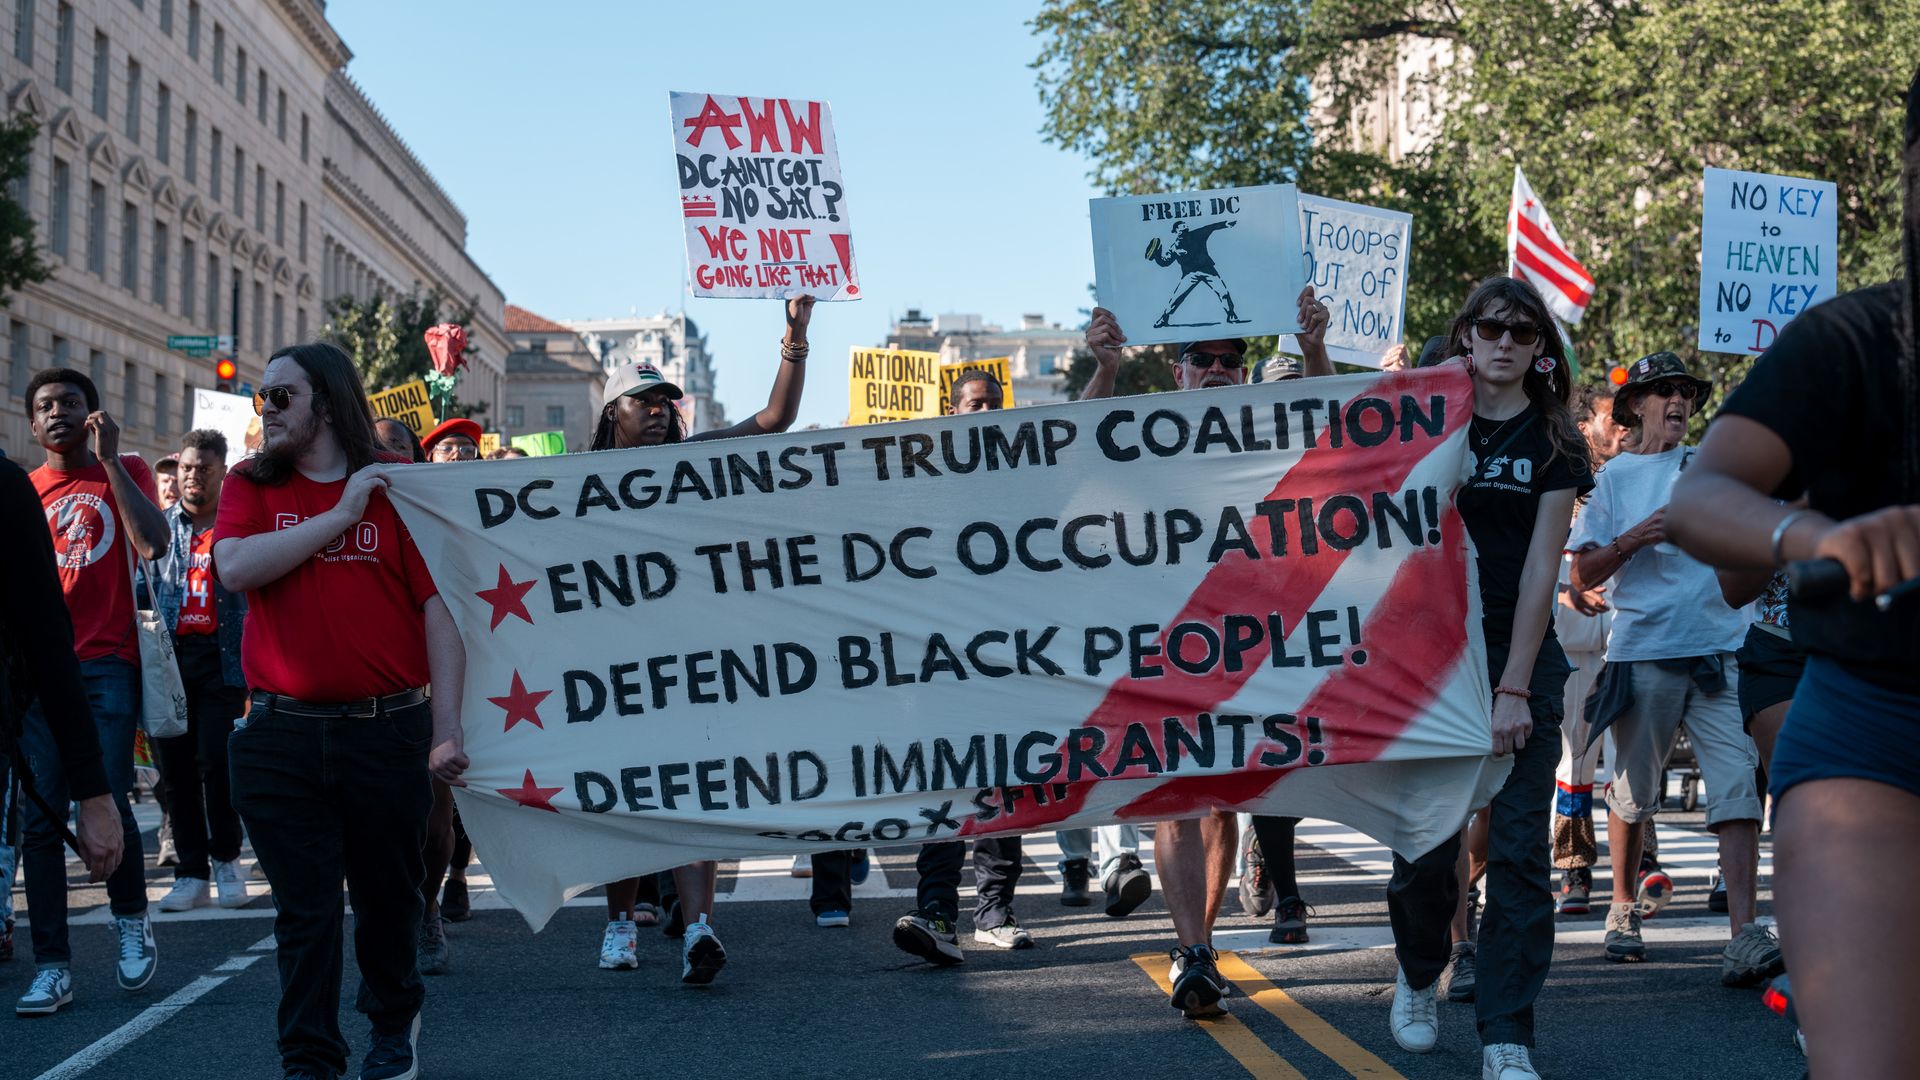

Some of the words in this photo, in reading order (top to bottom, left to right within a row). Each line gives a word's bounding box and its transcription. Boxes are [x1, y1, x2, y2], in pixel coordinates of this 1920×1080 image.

[684, 94, 824, 155] AWW
[676, 153, 721, 190] DC
[720, 156, 775, 188] AINT
[777, 158, 822, 186] GOT
[721, 186, 760, 225] NO
[1141, 199, 1201, 222] FREE
[1210, 196, 1240, 216] DC
[1731, 181, 1767, 211] NO
[1778, 186, 1824, 217] KEY
[757, 228, 811, 264] NOT
[1302, 209, 1400, 261] TROOPS
[1761, 221, 1781, 237] to
[1726, 240, 1819, 276] HEAVEN
[696, 263, 753, 290] GOING
[1361, 267, 1397, 299] of
[1716, 281, 1751, 313] NO
[1767, 283, 1818, 315] KEY
[1714, 327, 1732, 344] to
[853, 352, 936, 385] NATIONAL
[866, 382, 924, 413] GUARD
[475, 479, 560, 529] DC
[575, 441, 846, 517] AGAINST
[862, 419, 1077, 481] TRUMP
[1096, 395, 1446, 462] COALITION
[1493, 481, 1532, 494] Organization
[545, 551, 680, 614] END
[695, 534, 822, 594] THE
[842, 526, 937, 582] DC
[956, 486, 1442, 576] OCCUPATION!
[563, 641, 818, 724] DEFEND
[837, 626, 1066, 689] BLACK
[1083, 606, 1368, 679] PEOPLE!
[574, 750, 829, 814] DEFEND
[851, 713, 1326, 798] IMMIGRANTS!
